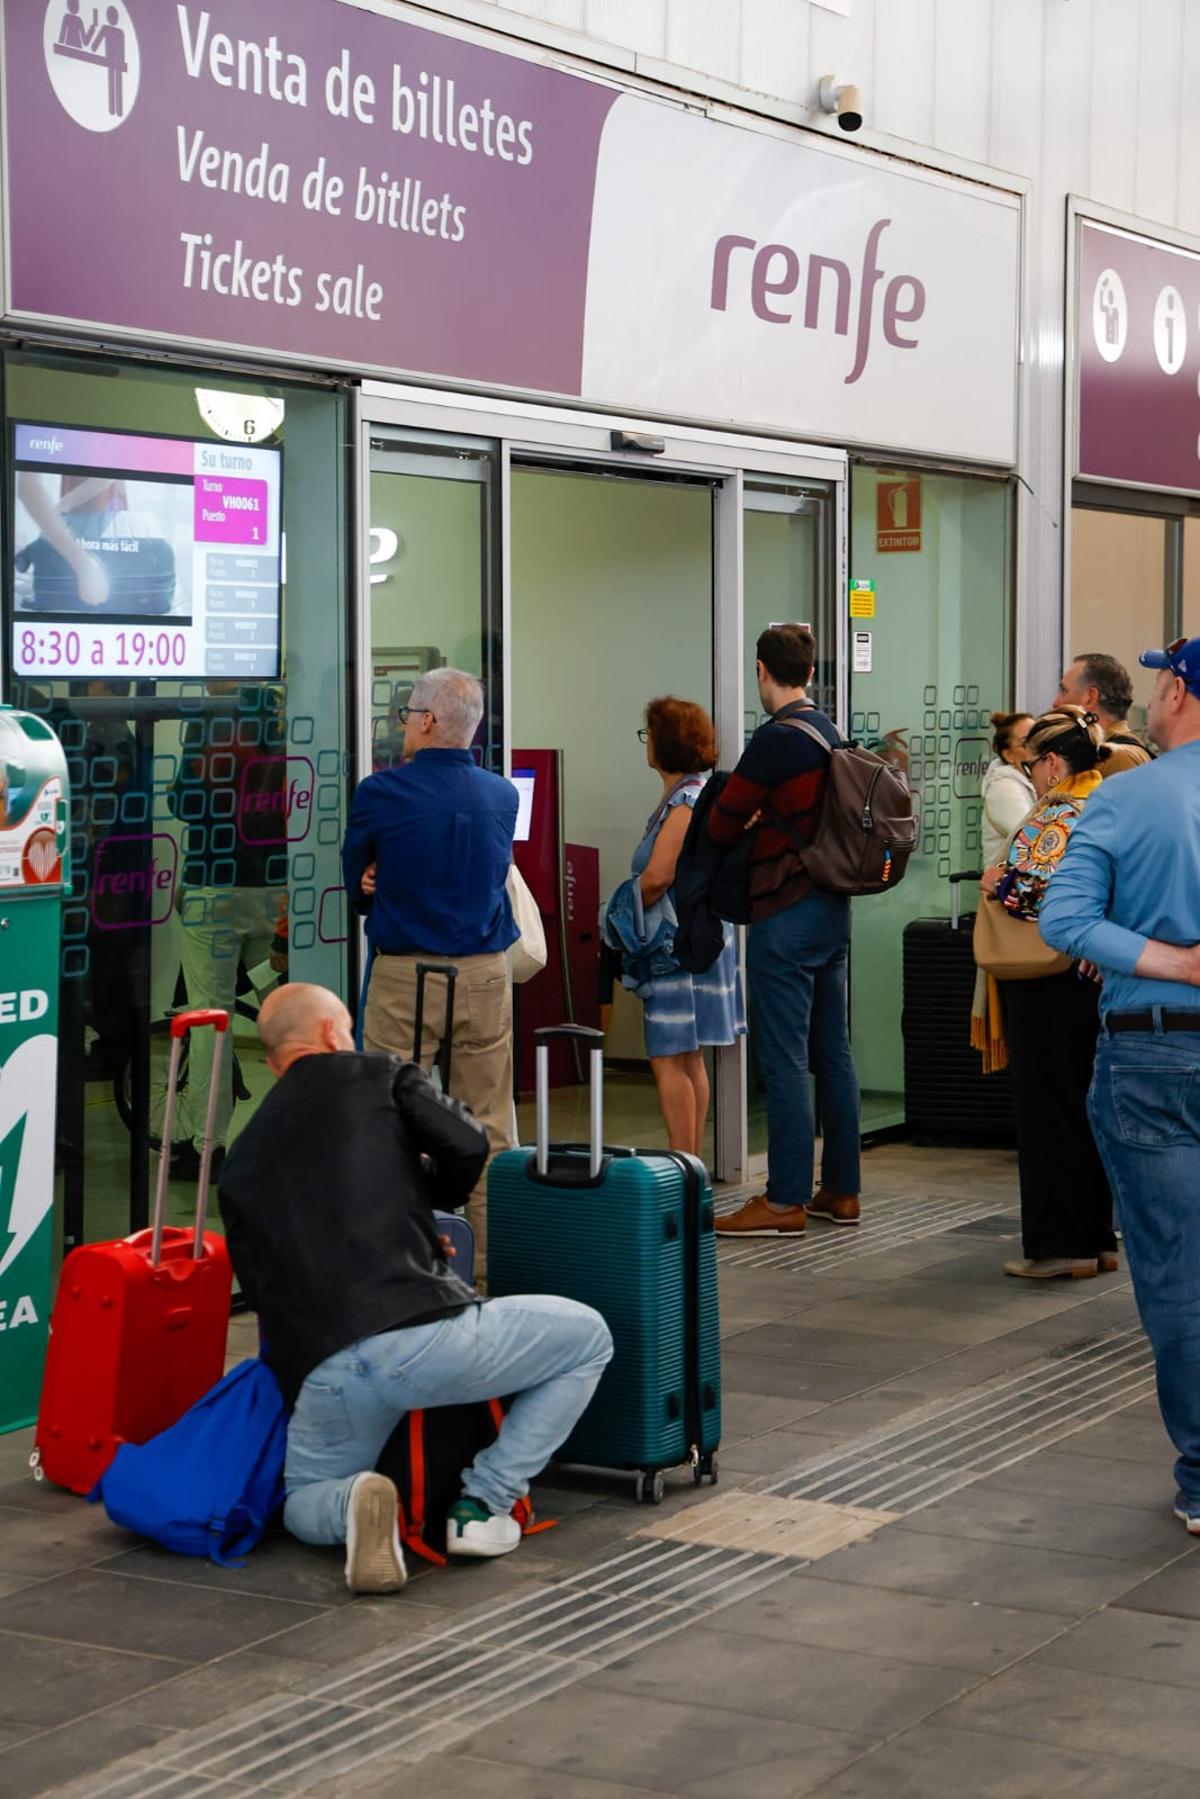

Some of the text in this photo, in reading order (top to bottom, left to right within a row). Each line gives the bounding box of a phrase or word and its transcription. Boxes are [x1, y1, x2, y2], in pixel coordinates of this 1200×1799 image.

[177, 4, 534, 166] Venta de billetes
[176, 125, 467, 243] Venda de bitllets
[180, 232, 384, 321] Tickets sale
[710, 218, 926, 385] renfe
[244, 419, 256, 435] 6
[29, 436, 64, 455] renfe
[201, 449, 253, 471] Su turno
[222, 495, 261, 512] VH0061
[252, 526, 260, 540] 1
[879, 536, 919, 548] EXTINTOR
[21, 630, 80, 665] 8:30
[91, 639, 104, 665] a
[116, 632, 186, 666] 19:00
[956, 753, 989, 783] renfe
[244, 779, 310, 819] renfe
[98, 857, 172, 901] renfe
